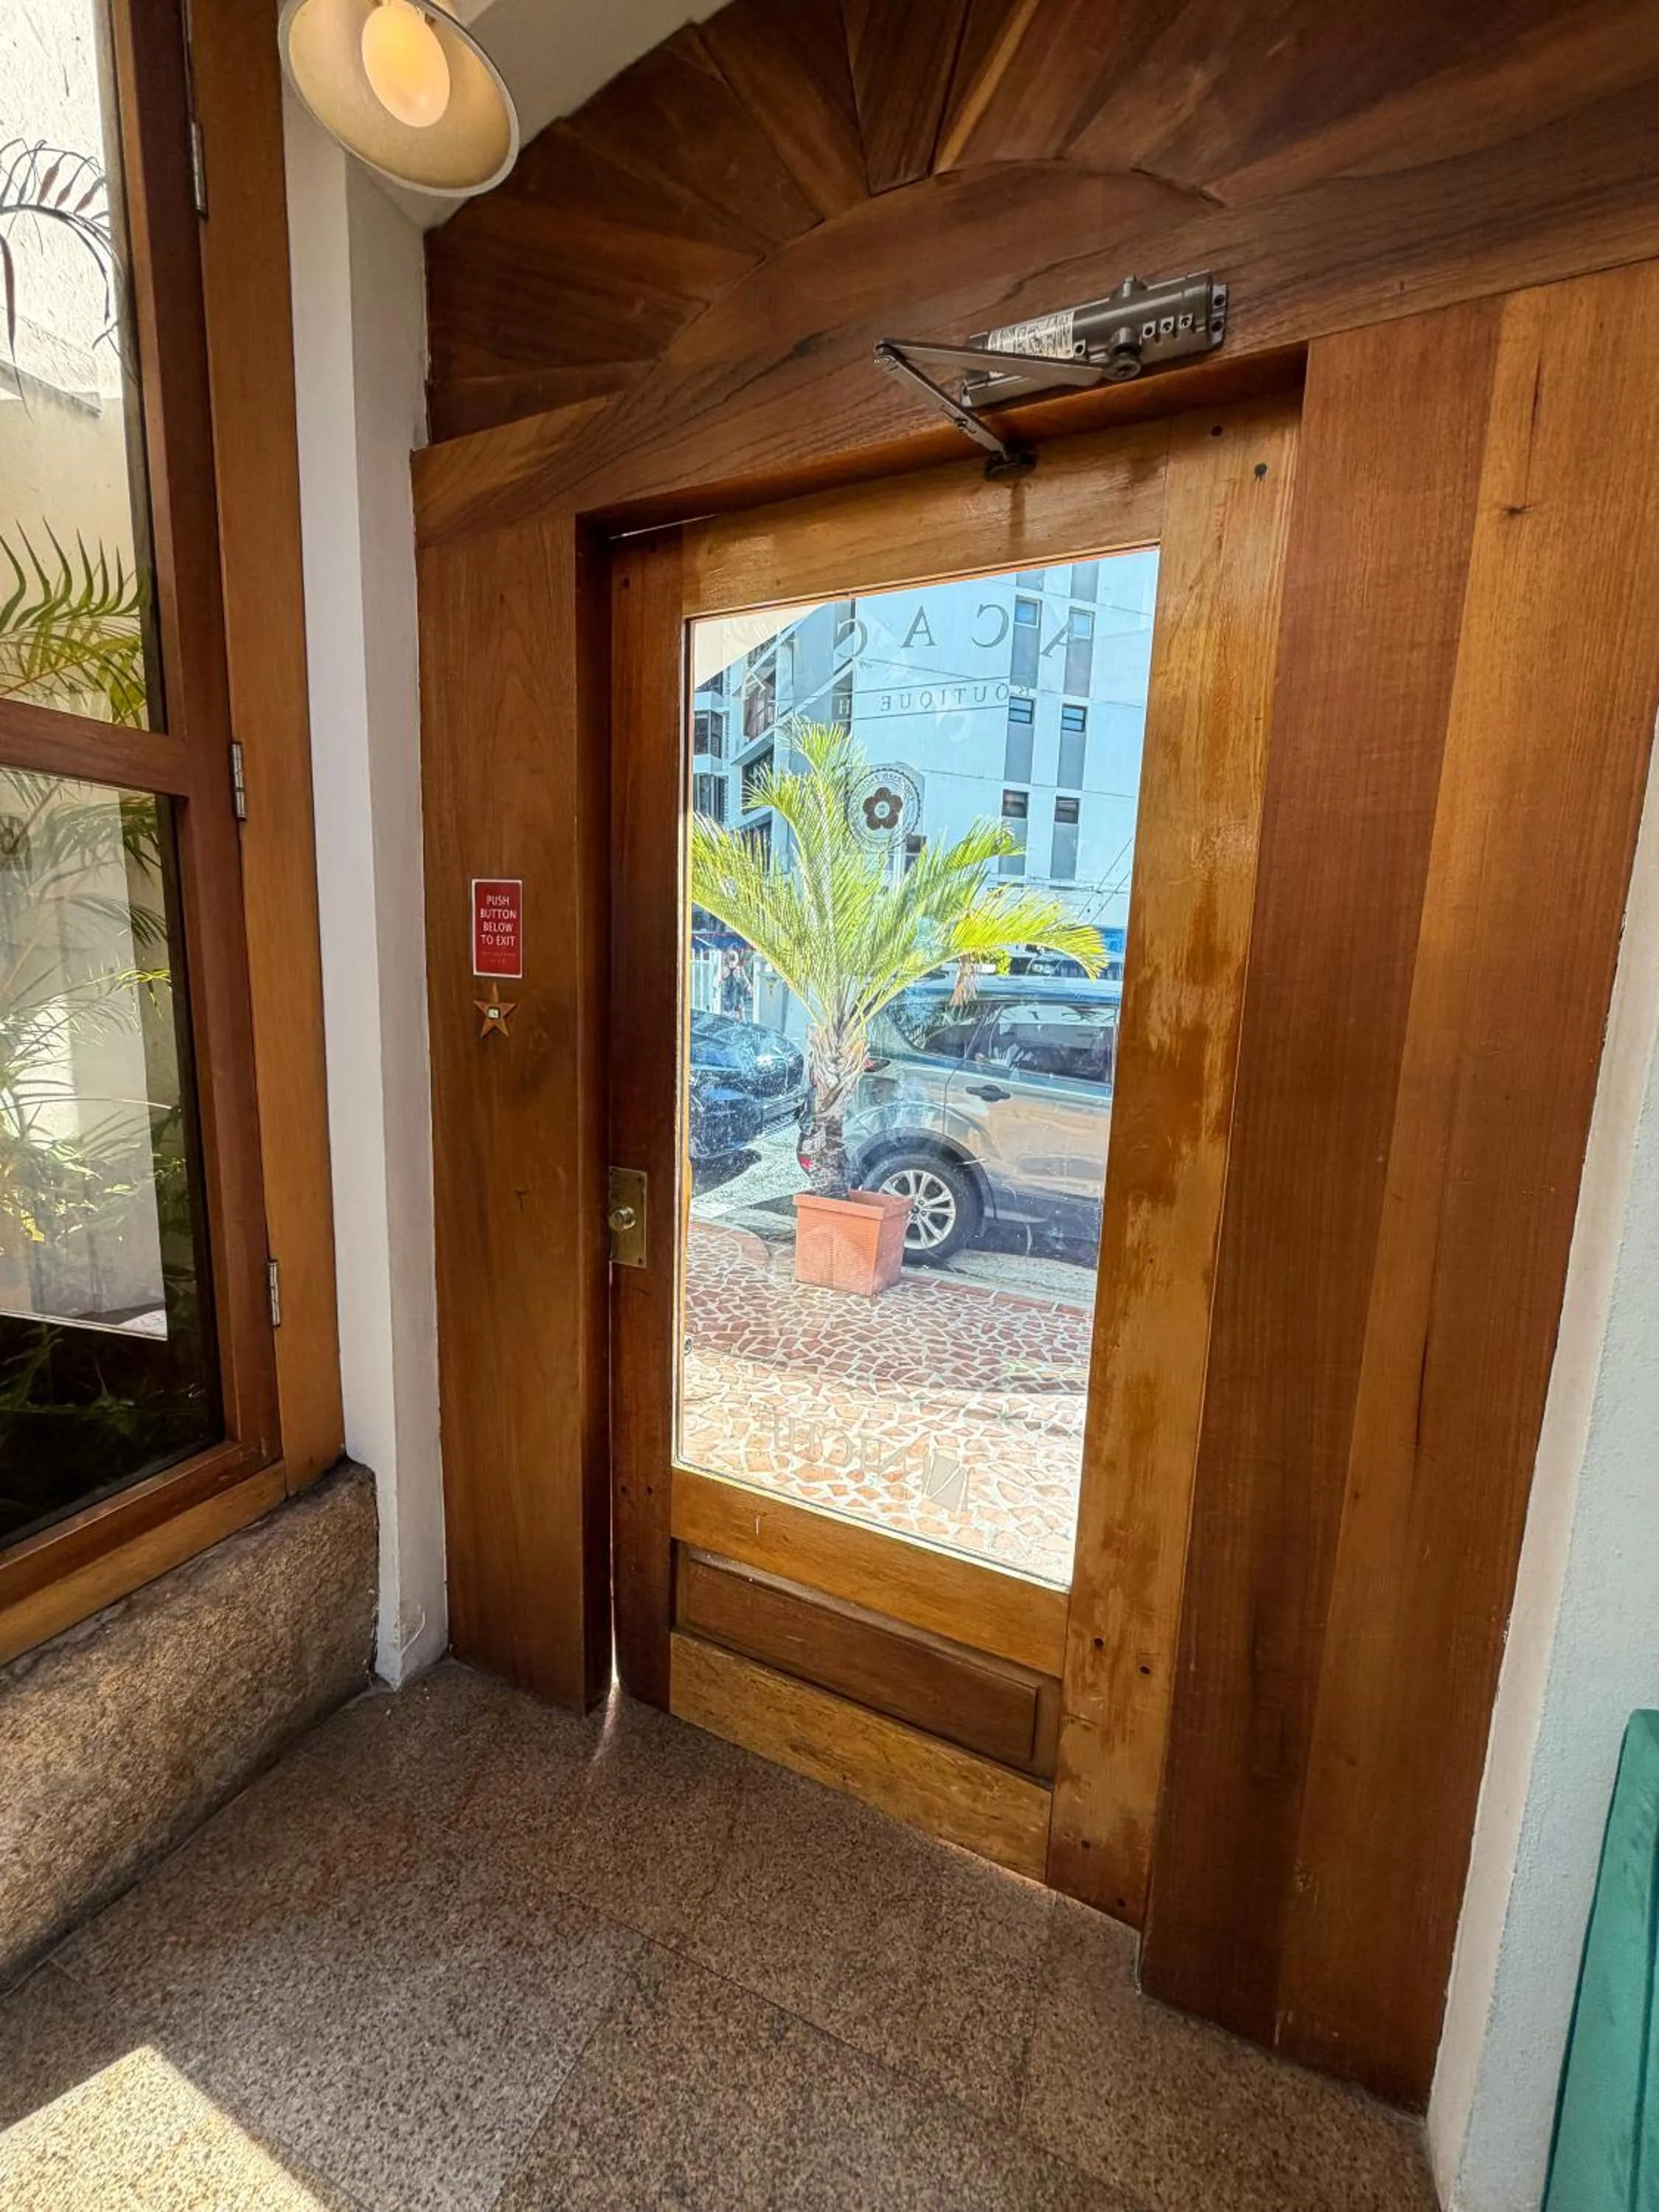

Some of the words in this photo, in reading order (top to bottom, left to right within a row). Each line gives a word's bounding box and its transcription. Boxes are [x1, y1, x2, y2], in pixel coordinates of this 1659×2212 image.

[486, 894, 509, 906] PUSH
[480, 908, 517, 919] BUTTON
[483, 921, 514, 933] BELOW
[480, 934, 493, 945] TO
[495, 935, 515, 947] EXIT
